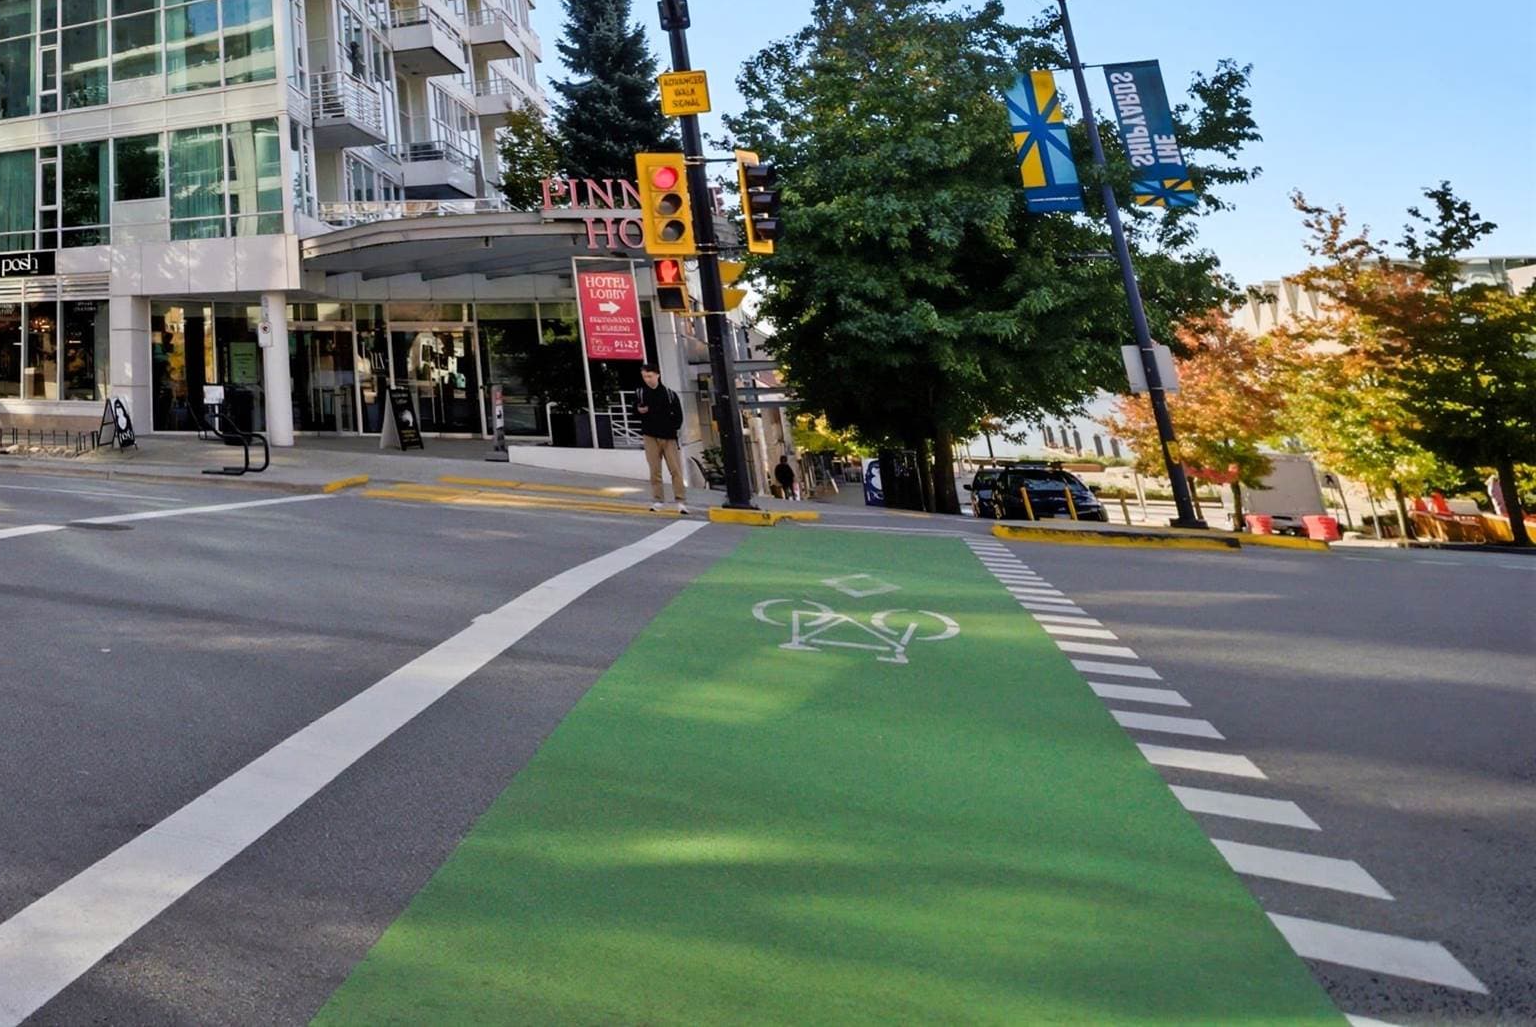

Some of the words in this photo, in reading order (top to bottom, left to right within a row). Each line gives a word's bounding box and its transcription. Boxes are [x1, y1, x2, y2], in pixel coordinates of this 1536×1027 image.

[539, 177, 642, 210] PINN
[1, 253, 39, 277] posh
[585, 276, 630, 289] HOTEL
